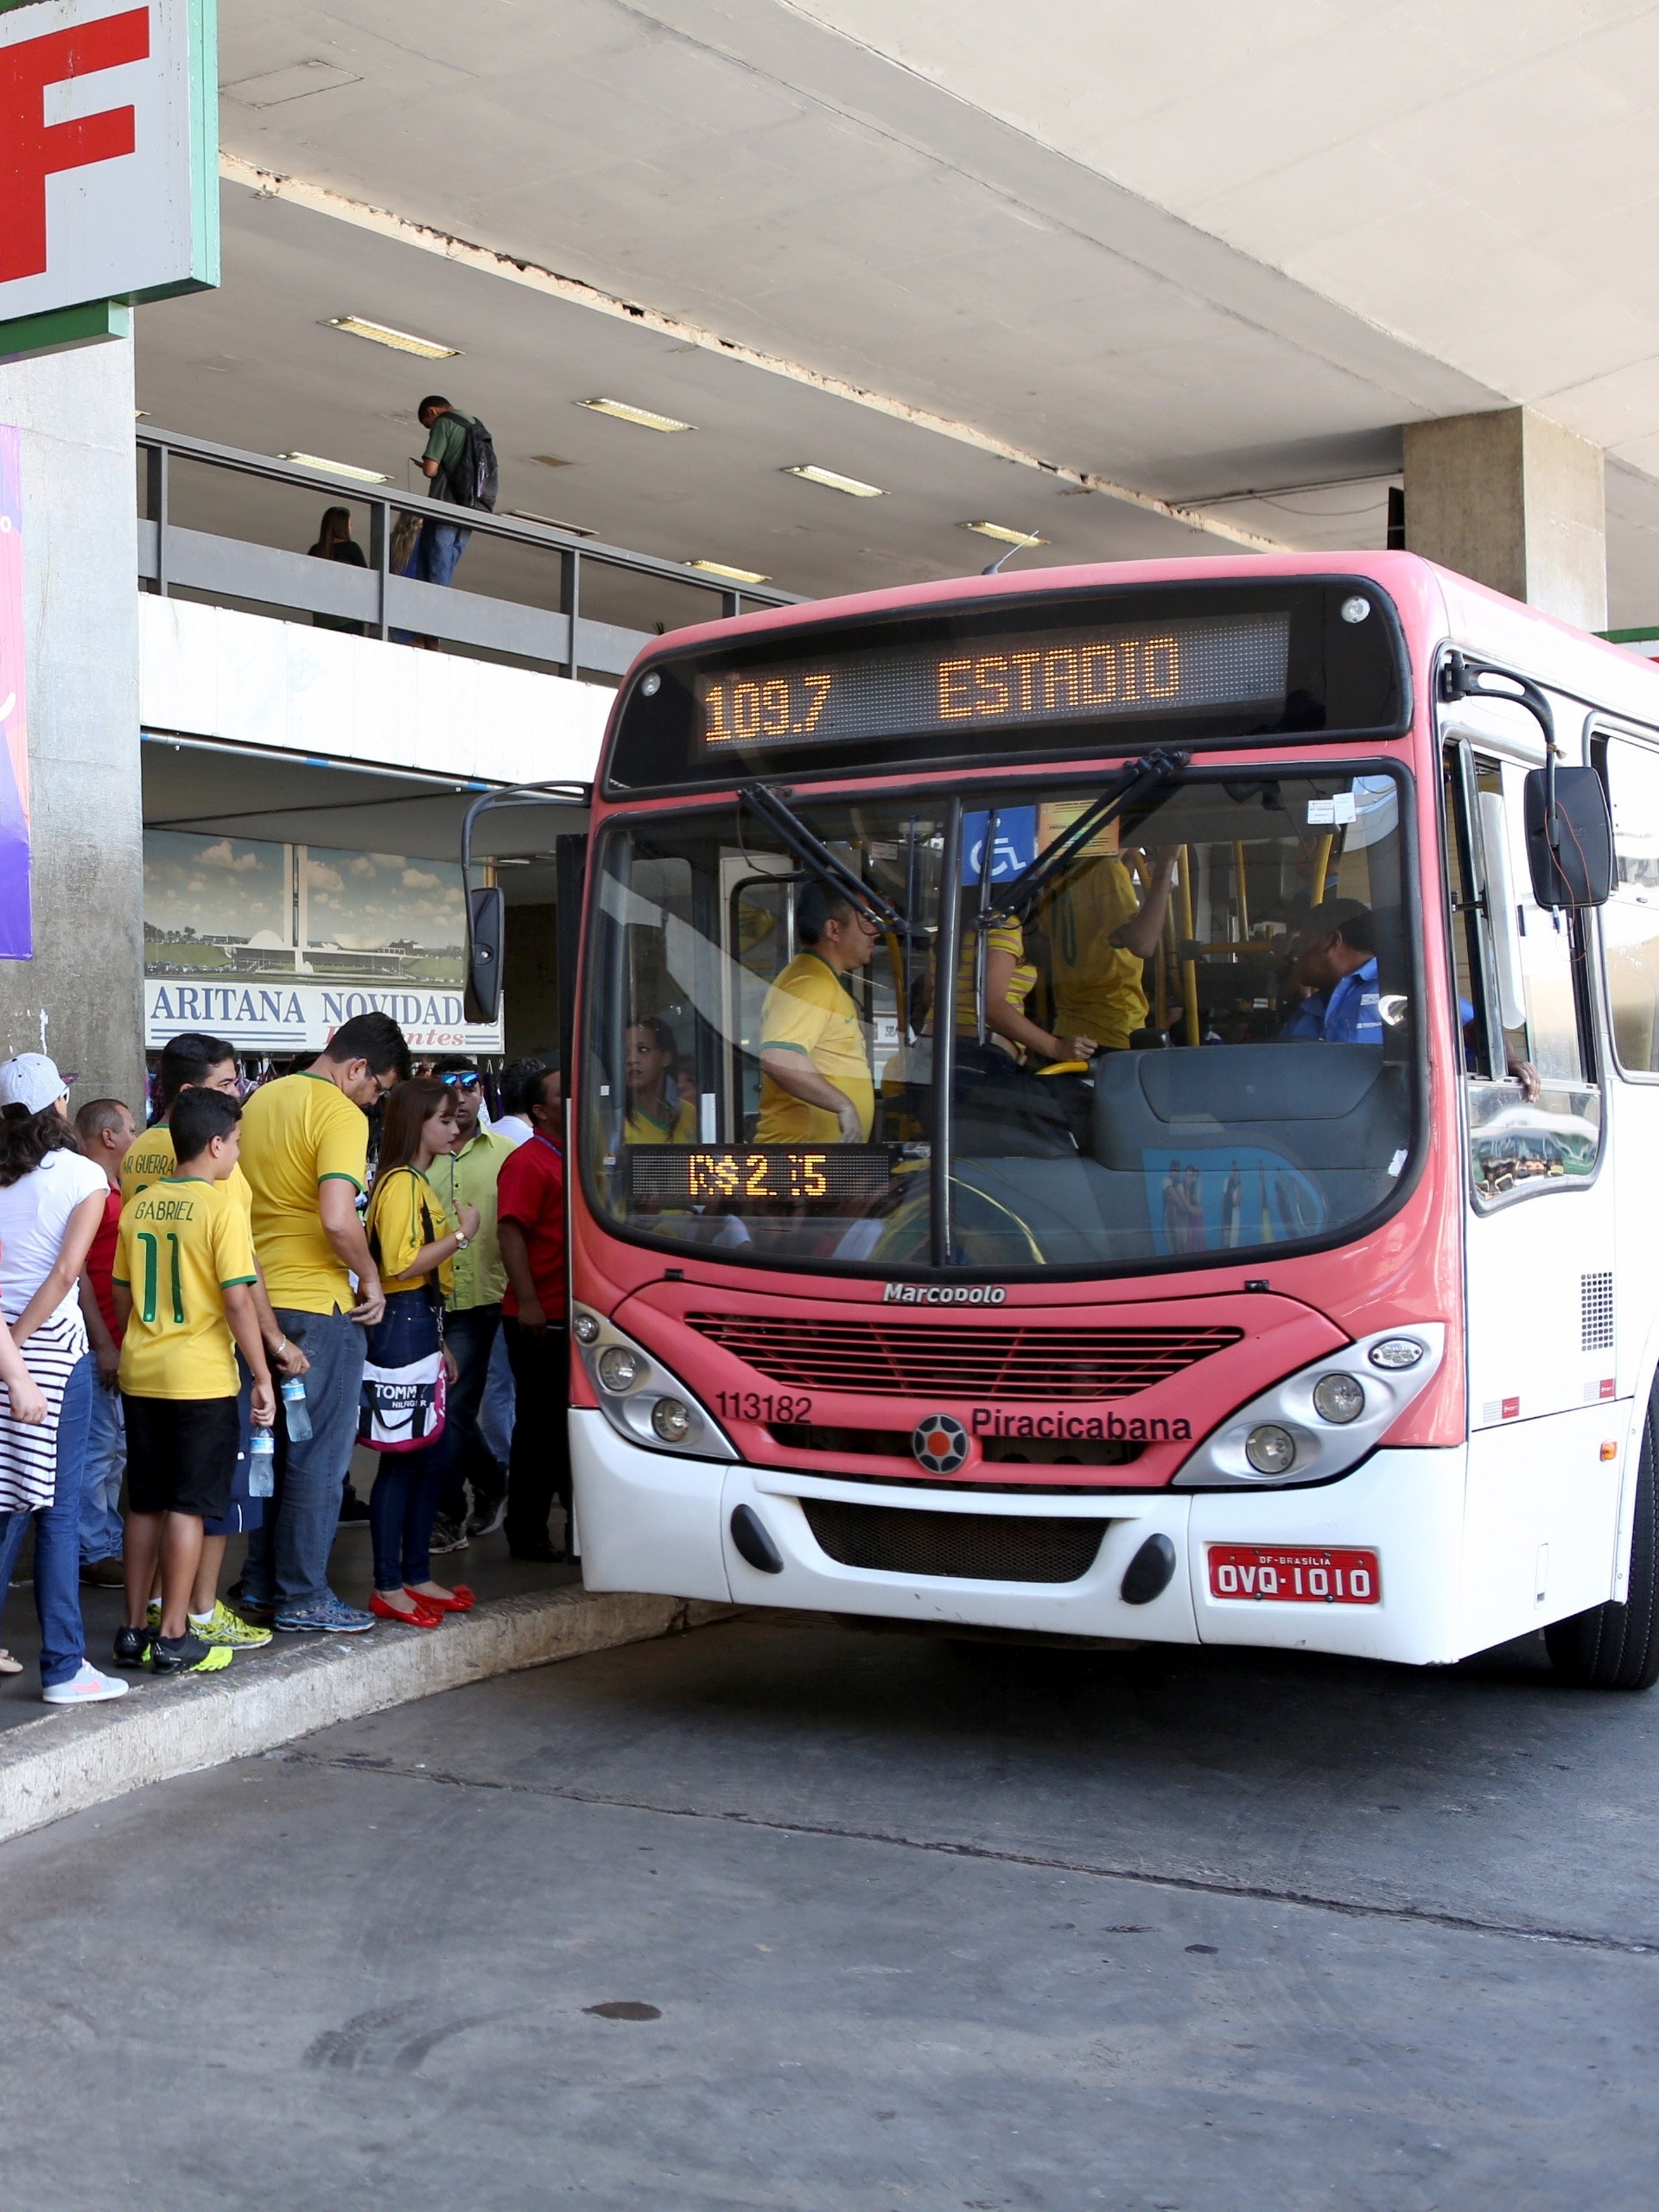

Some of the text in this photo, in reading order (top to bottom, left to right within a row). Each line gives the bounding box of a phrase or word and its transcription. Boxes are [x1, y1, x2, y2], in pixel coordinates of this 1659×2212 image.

[0, 6, 149, 283] F
[705, 637, 1180, 741] 109.7 ESTADIO
[150, 986, 499, 1027] ARITANA NOVIDAD
[136, 1154, 175, 1174] GUERRA
[135, 1200, 194, 1221] GABRIEL
[137, 1232, 184, 1324] 11
[375, 1384, 428, 1400] TOMM
[715, 1391, 1192, 1440] 113182 Piracicabana
